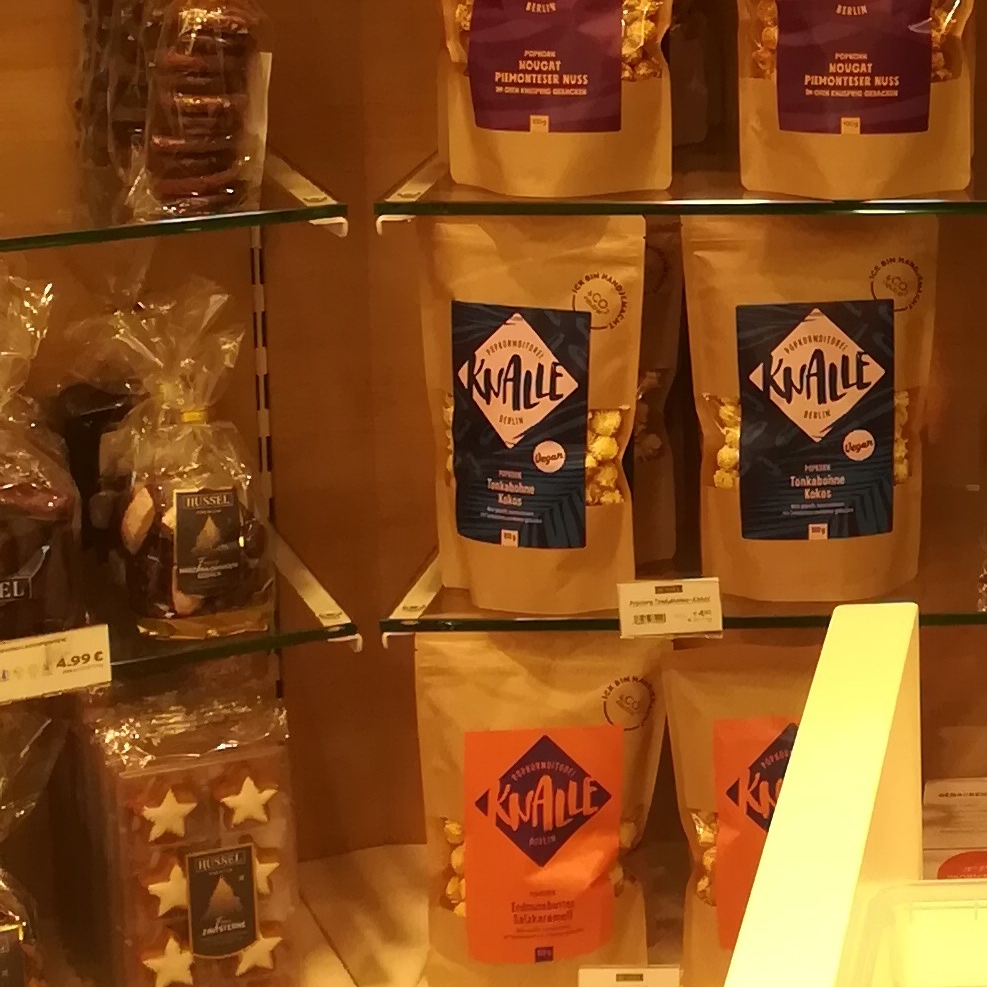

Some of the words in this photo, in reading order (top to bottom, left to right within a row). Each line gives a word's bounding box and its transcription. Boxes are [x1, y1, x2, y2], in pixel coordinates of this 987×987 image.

[836, 3, 868, 16] BERLIN
[518, 60, 562, 71] NOUGAT
[829, 63, 873, 73] NOUGAT
[495, 71, 560, 84] PIEMONTESER
[562, 74, 589, 85] NUSS
[804, 74, 872, 86] PIEMONTESER
[874, 76, 900, 86] NUSS
[467, 353, 565, 413] KNALLE
[763, 348, 873, 406] KNALLE
[844, 440, 874, 453] Vegan
[534, 452, 564, 466] Vegan
[790, 474, 846, 488] Tonkabohne
[186, 494, 231, 508] HUSSEL
[804, 488, 832, 500] Kokos
[494, 774, 599, 832] KNALLE
